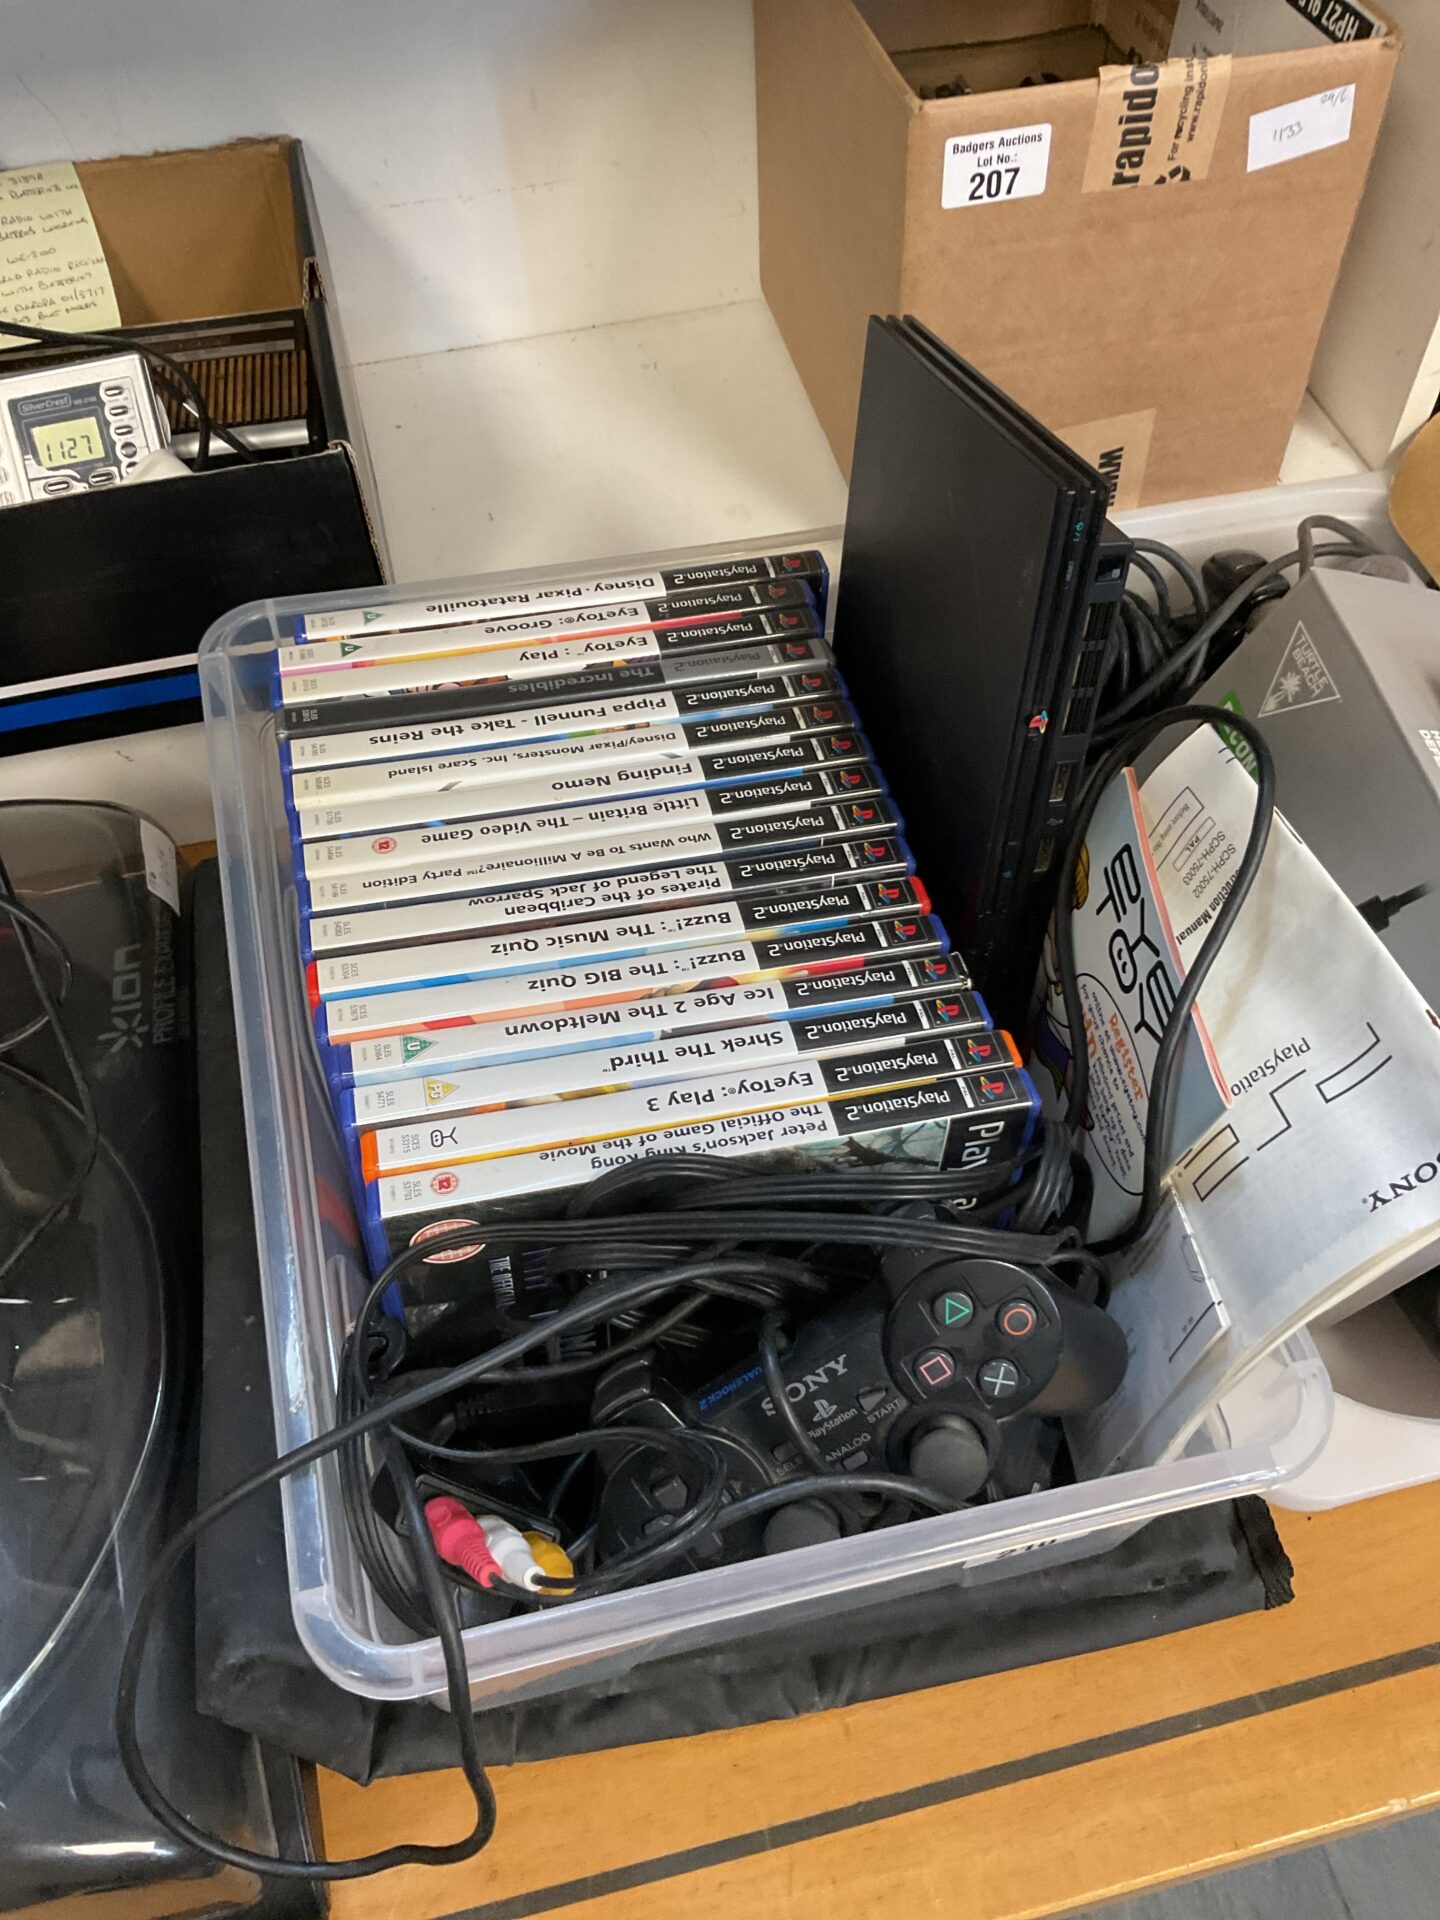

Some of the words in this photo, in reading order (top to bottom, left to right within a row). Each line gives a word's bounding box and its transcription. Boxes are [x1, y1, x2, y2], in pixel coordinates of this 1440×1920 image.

[952, 140, 995, 155] Badgers
[998, 132, 1043, 148] Auctions
[977, 156, 993, 167] Lot
[968, 167, 1021, 201] 207
[535, 584, 583, 601] Pixar
[594, 578, 655, 593] Disney
[425, 593, 530, 614] Ratatouille
[484, 619, 553, 635] Groove
[519, 648, 560, 662] Play
[1294, 632, 1329, 688] TURTLE
[619, 666, 655, 679] The
[1292, 647, 1324, 698] BEACH
[508, 669, 615, 694] Incredibles
[612, 698, 667, 713] Pippa
[534, 706, 607, 727] Funnell
[430, 724, 464, 738] the
[471, 718, 516, 734] Take
[369, 729, 424, 746] Reins
[590, 731, 677, 752] Disney/Pixar
[481, 753, 508, 764] Inc.
[513, 742, 585, 761] Monsters,
[388, 762, 433, 780] Island
[438, 757, 477, 770] Scare
[616, 761, 693, 782] Finding
[551, 775, 612, 791] Nemo
[652, 796, 700, 812] Little
[588, 803, 648, 822] Britain
[480, 822, 532, 838] Video
[536, 815, 569, 829] The
[420, 829, 473, 845] Game
[628, 837, 675, 852] Wants
[678, 831, 712, 844] Who
[571, 850, 582, 861] A
[586, 847, 605, 858] Be
[609, 844, 626, 854] To
[1182, 830, 1227, 887] SCPH-75003
[422, 867, 463, 883] Party
[616, 869, 681, 883] Legend
[685, 864, 718, 876] The
[1192, 843, 1237, 899] SCPH-75002
[362, 874, 418, 890] Edition
[549, 883, 585, 897] Jack
[592, 878, 612, 891] of
[660, 877, 722, 894] Pirates
[468, 888, 545, 907] Sparrow
[601, 891, 631, 903] the
[636, 886, 656, 900] of
[503, 895, 596, 917] Caribbean
[616, 923, 656, 938] The
[1175, 908, 1214, 945] Manual
[490, 937, 539, 956] Quiz
[546, 929, 610, 948] Music
[584, 969, 623, 985] BIG
[628, 962, 669, 977] The
[527, 974, 577, 993] Quiz
[693, 992, 736, 1008] Age
[743, 987, 775, 1000] Ice
[627, 1004, 669, 1019] The
[675, 1000, 687, 1013] 2
[504, 1010, 621, 1037] Meltdown
[721, 1031, 784, 1051] Shrek
[674, 1042, 716, 1058] The
[1230, 1036, 1312, 1098] PlayStatio
[646, 1097, 661, 1112] 3
[667, 1089, 715, 1107] Play
[789, 1103, 823, 1118] The
[721, 1109, 786, 1132] Official
[780, 1119, 828, 1137] Peter
[636, 1132, 657, 1146] of
[662, 1123, 716, 1139] Game
[601, 1137, 633, 1151] the
[692, 1129, 774, 1153] Jackson's
[539, 1144, 597, 1162] Movie
[866, 1399, 901, 1425] START
[824, 1421, 872, 1463] ANALOG
